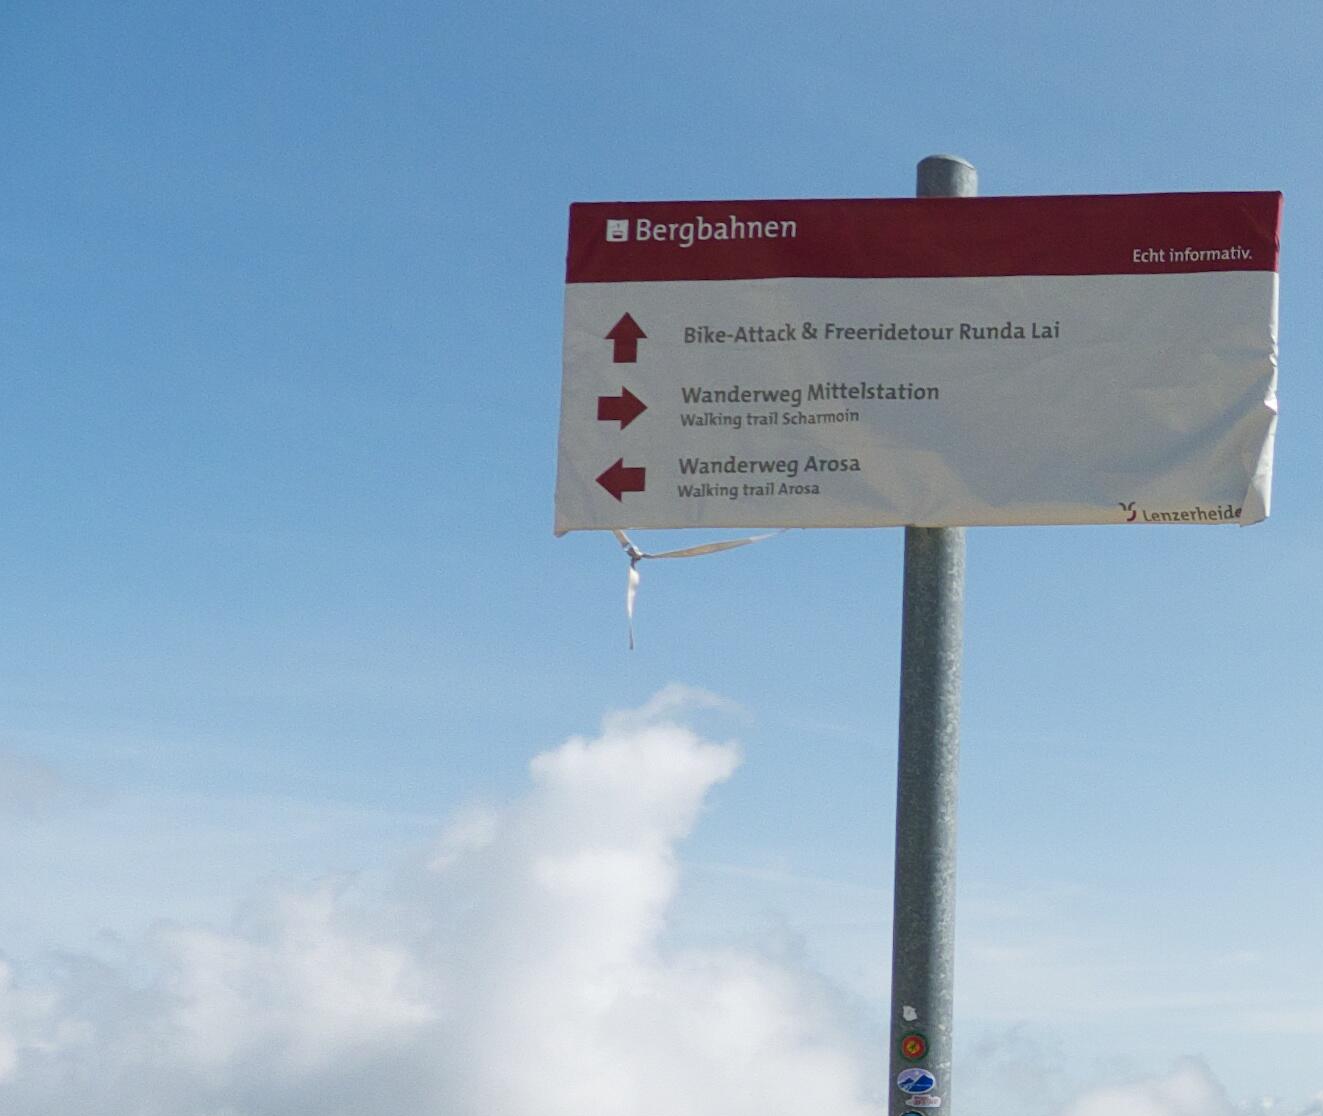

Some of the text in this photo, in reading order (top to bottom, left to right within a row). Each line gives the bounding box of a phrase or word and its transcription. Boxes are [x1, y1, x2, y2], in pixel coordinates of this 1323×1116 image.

[636, 215, 797, 247] Bergbahnen
[1132, 245, 1253, 263] Echt informativ.
[684, 321, 1060, 344] Bike-Attack & Freeridetour Runda Lai
[682, 382, 939, 407] Wanderweg Mittelstation
[680, 408, 860, 430] Walking trail Scharmoin
[678, 455, 861, 477] Wanderweg Arosa
[677, 482, 820, 500] Walking trail Arosa
